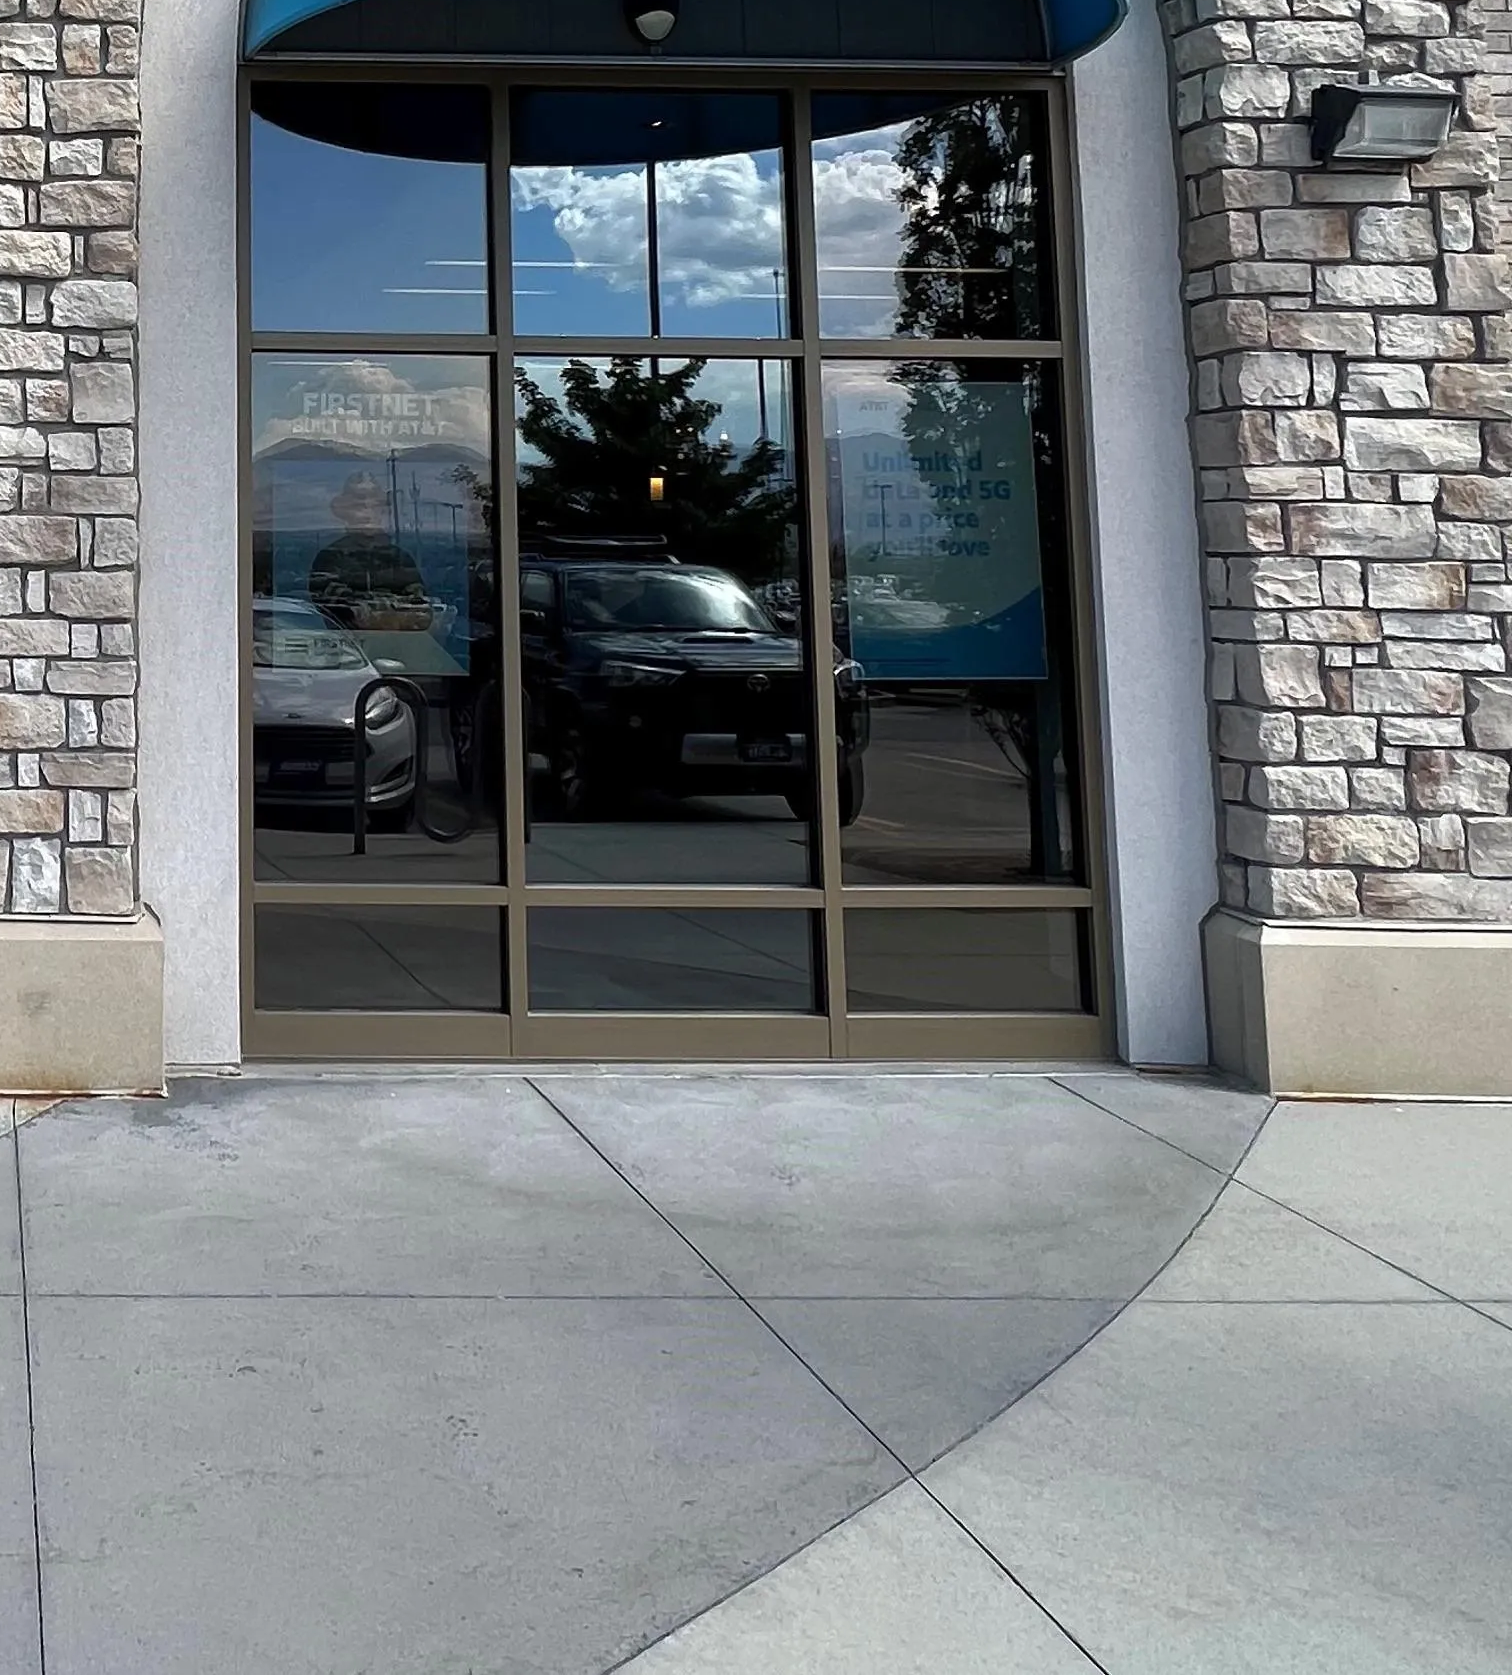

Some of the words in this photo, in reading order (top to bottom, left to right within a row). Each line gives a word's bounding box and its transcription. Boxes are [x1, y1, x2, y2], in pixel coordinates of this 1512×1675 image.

[303, 392, 437, 417] FIRSTNET
[292, 418, 340, 433] BUILT
[346, 419, 392, 435] WITH
[979, 480, 1011, 500] 5G
[899, 512, 912, 528] a
